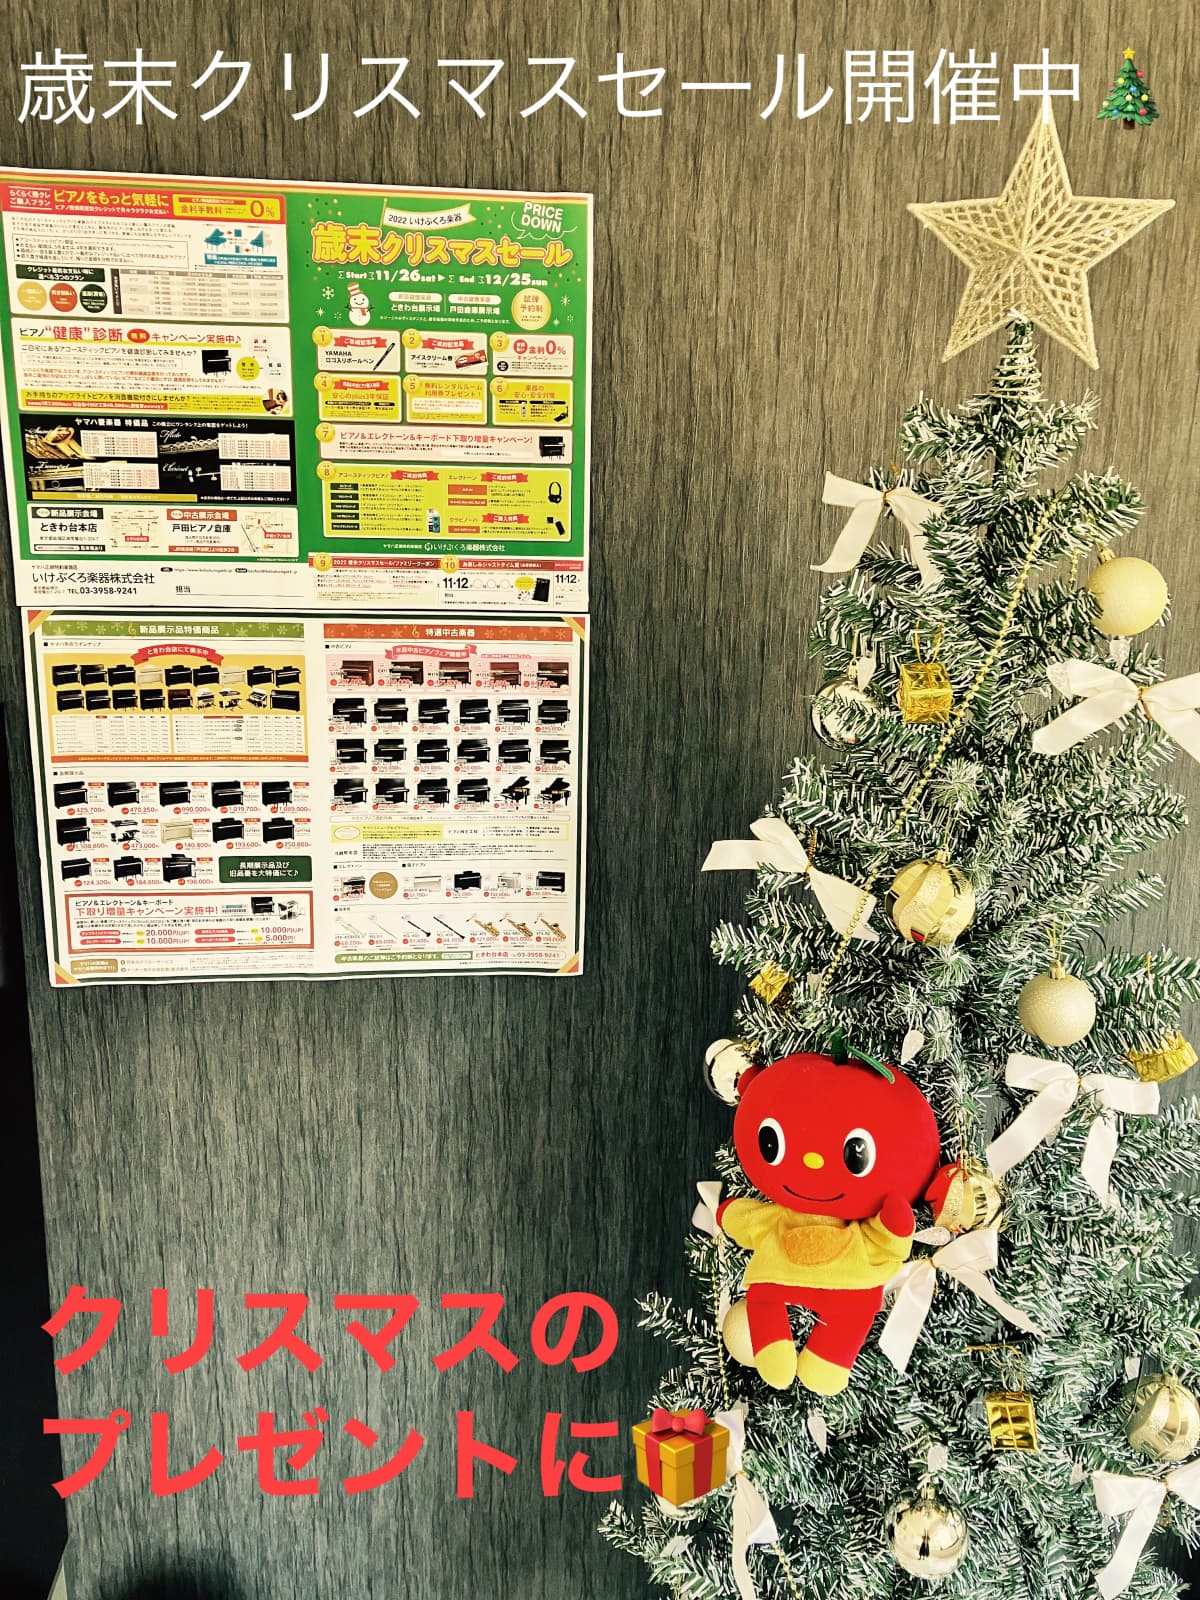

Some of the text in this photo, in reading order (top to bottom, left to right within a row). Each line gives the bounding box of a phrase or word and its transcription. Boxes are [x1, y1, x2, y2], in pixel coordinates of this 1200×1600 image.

[53, 189, 170, 207] ピアノをもっと気軽に
[250, 199, 275, 218] 0%
[523, 201, 564, 221] PRICE
[387, 212, 463, 226] 2022 いけぶくろ楽器
[521, 213, 562, 233] DOWN
[311, 221, 574, 267] 歳末クリスマスセール
[325, 357, 375, 365] ロゴ入りボールペン
[411, 353, 453, 362] アイスクリーム券
[183, 511, 230, 520] 中古展示会場
[40, 522, 98, 533] ときわ台本店
[172, 523, 232, 533] 戸田ピアノ倉庫
[32, 571, 156, 584] いけぶくろ楽器株式会社
[175, 585, 191, 593] 担当
[139, 624, 220, 635] 新品展示品特価商品
[76, 905, 218, 916] 下取り増量キャンペーン実施中!
